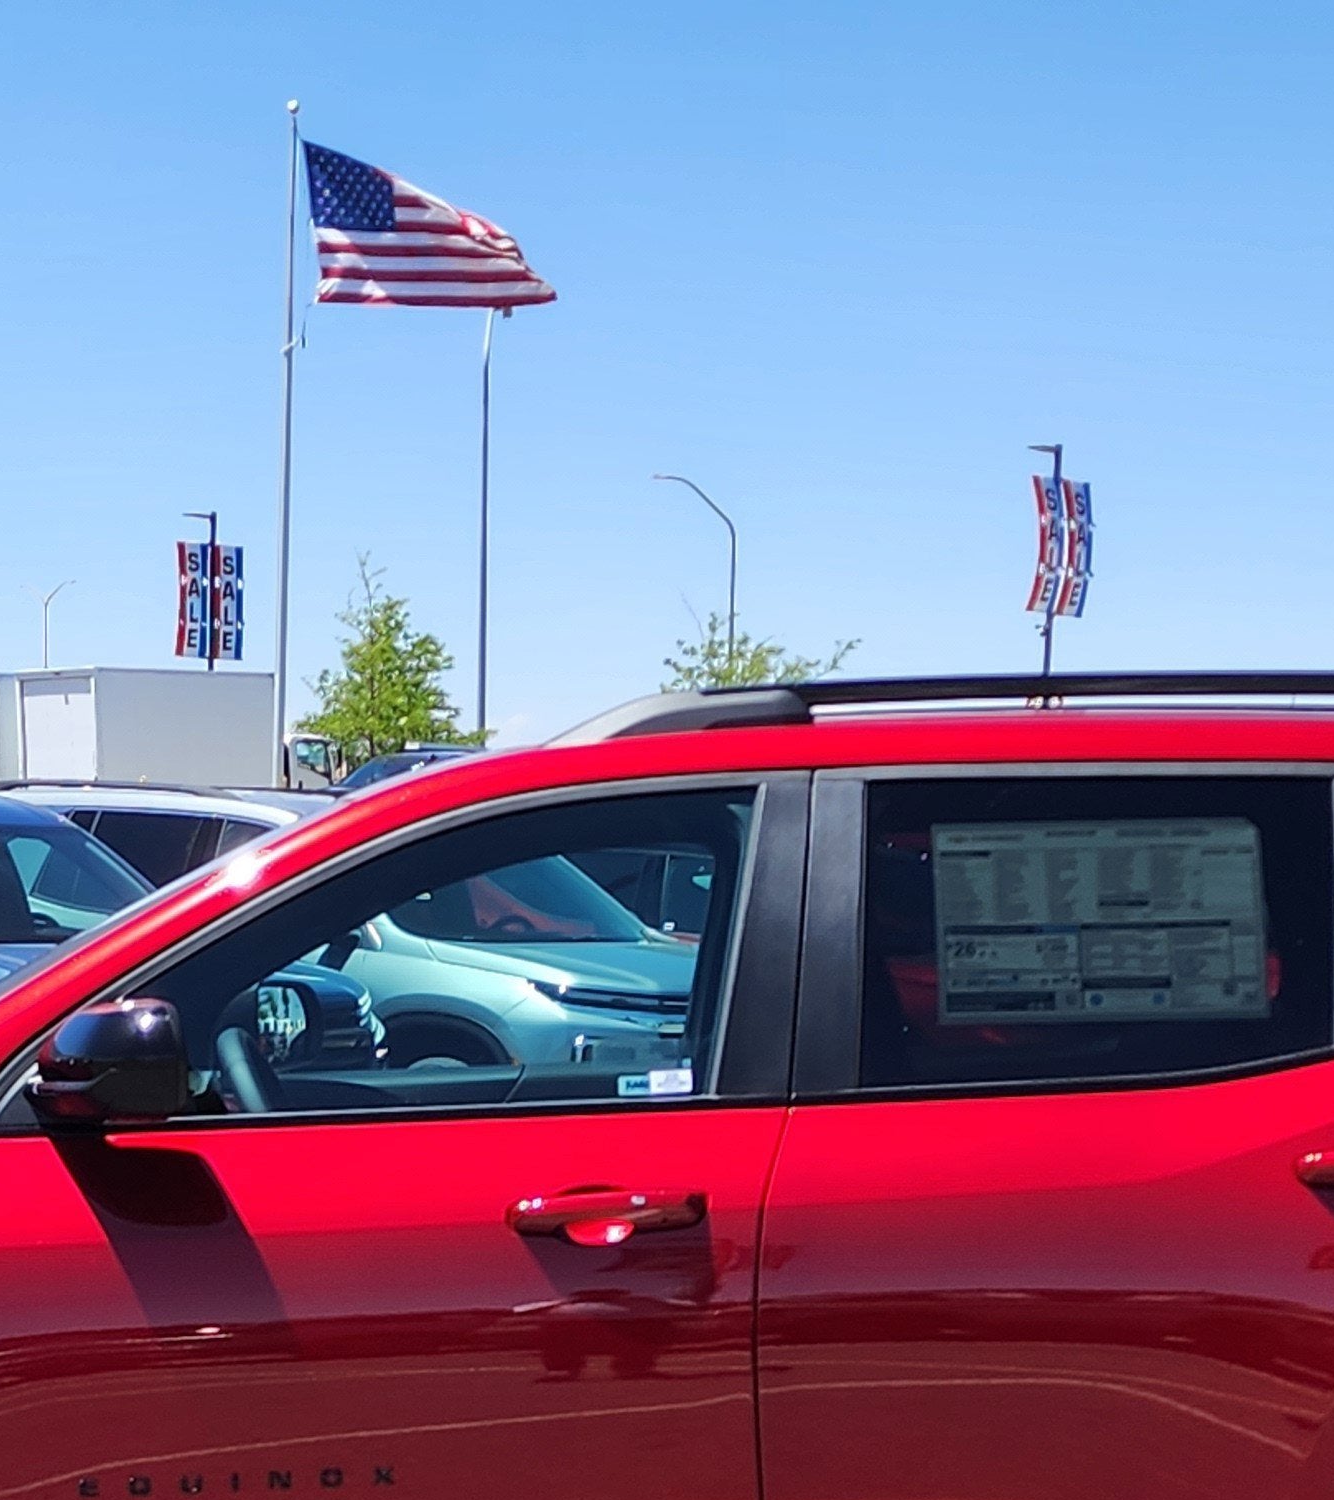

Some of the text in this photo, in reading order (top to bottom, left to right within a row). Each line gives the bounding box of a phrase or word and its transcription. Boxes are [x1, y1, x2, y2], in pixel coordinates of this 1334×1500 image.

[1040, 488, 1059, 603] SALE
[1068, 493, 1086, 607] SALE
[187, 552, 201, 648] SALE
[222, 556, 236, 651] SALE
[77, 1465, 396, 1498] EQUINOX
